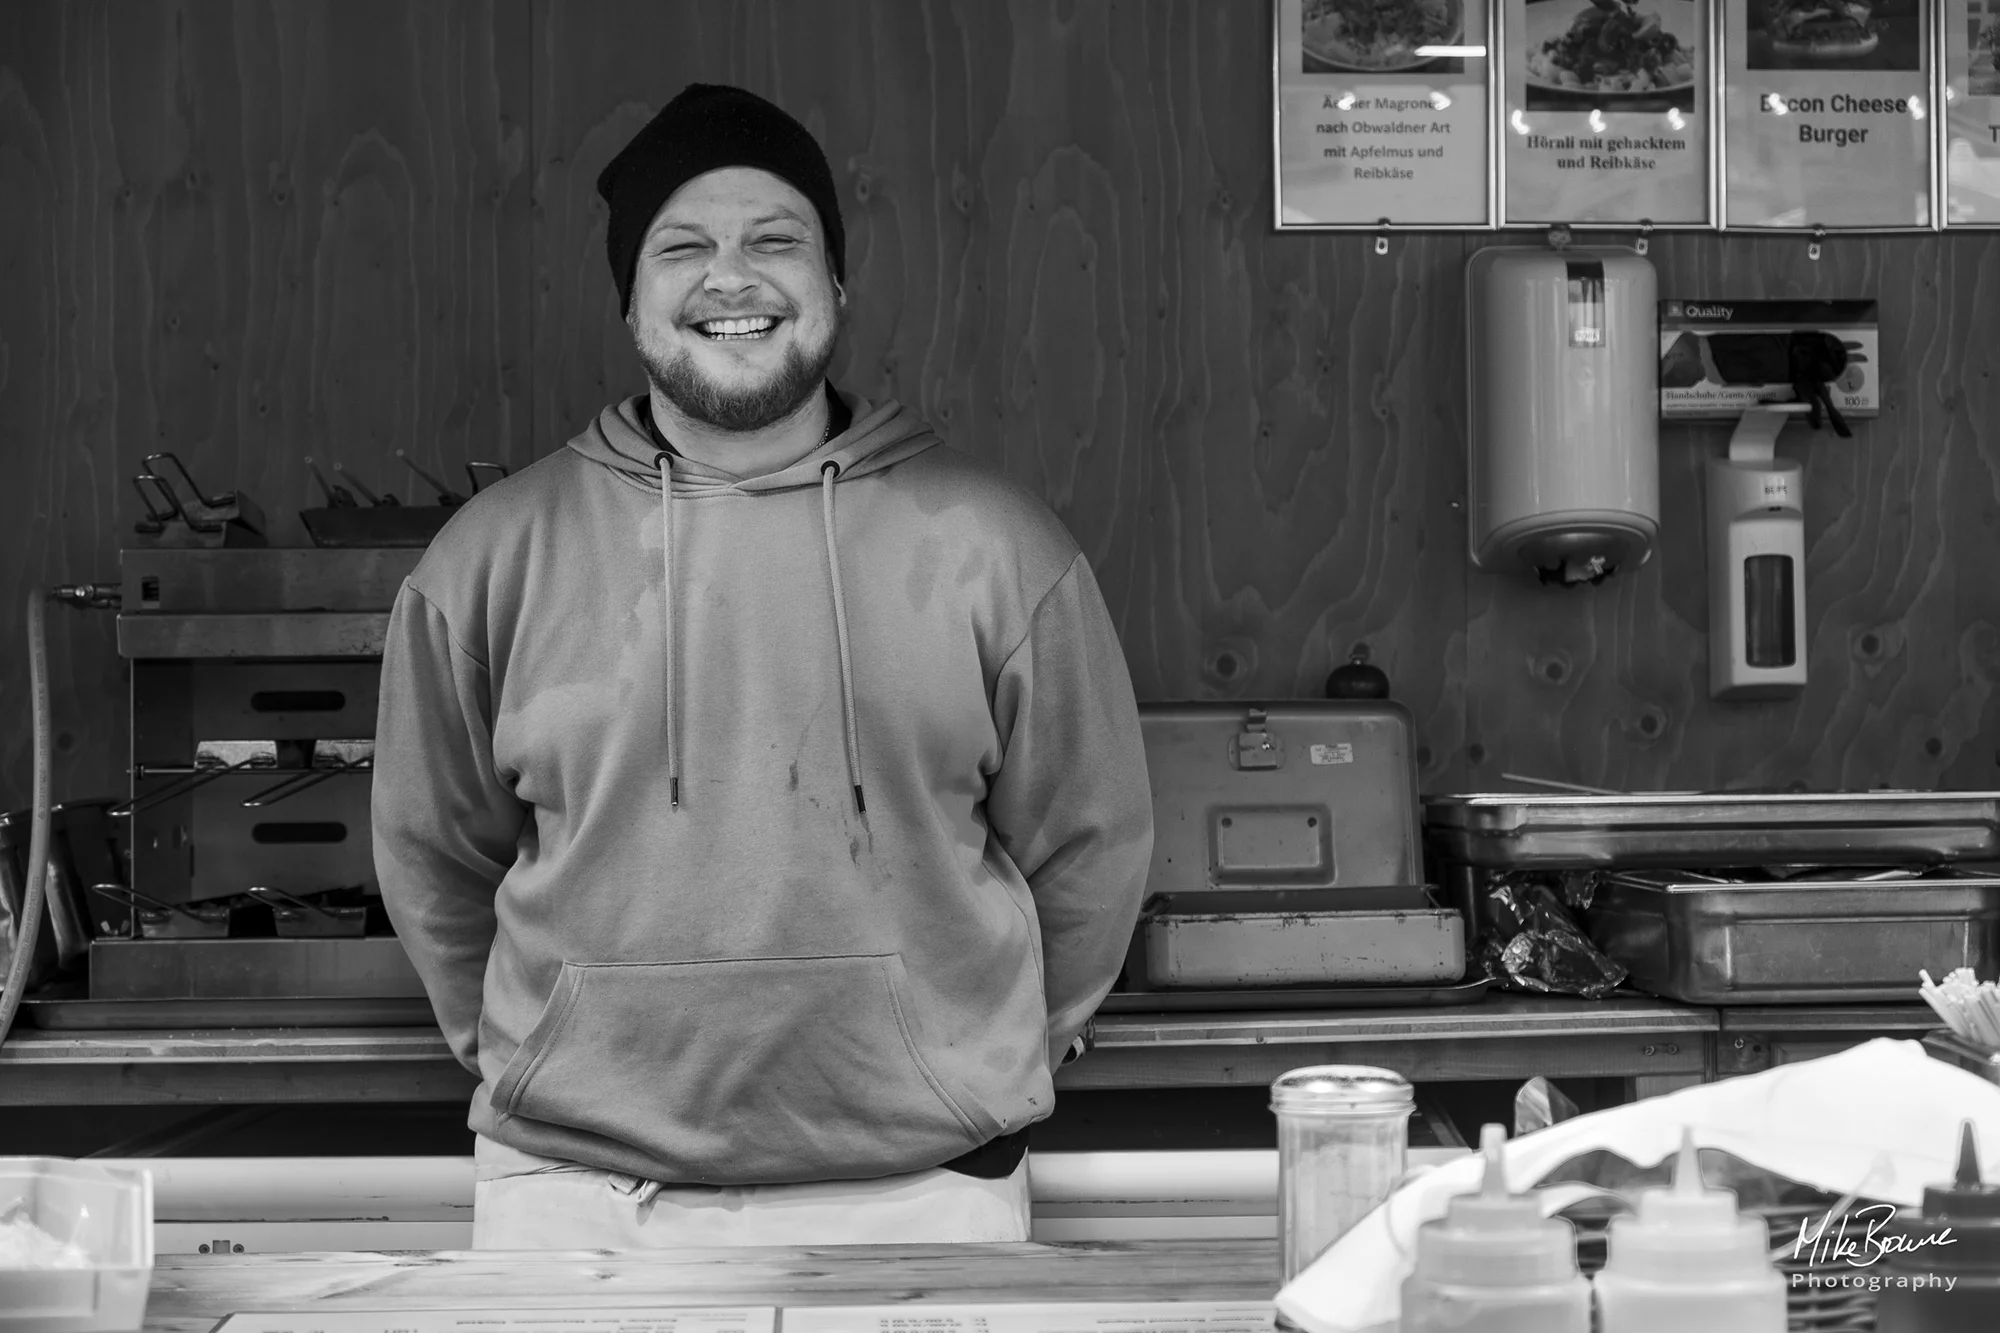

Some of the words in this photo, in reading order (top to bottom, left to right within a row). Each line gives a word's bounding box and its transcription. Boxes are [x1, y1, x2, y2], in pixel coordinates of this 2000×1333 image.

[1375, 97, 1438, 112] Magrone
[1760, 94, 1825, 113] Bcon
[1831, 94, 1908, 113] Cheese
[1316, 121, 1348, 133] nach
[1352, 121, 1427, 133] Obwaldner
[1430, 122, 1451, 133] Art
[1988, 124, 2000, 143] T
[1799, 124, 1868, 147] Burger
[1527, 136, 1575, 149] Hörnli
[1579, 136, 1603, 149] mit
[1607, 136, 1685, 152] gehacktem
[1324, 145, 1346, 157] mit
[1350, 145, 1414, 160] Apfelmus
[1418, 146, 1444, 157] und
[1556, 155, 1585, 169] und
[1590, 155, 1656, 169] Reibkäse
[1354, 167, 1414, 179] Reibkäse
[1686, 305, 1734, 320] Quality
